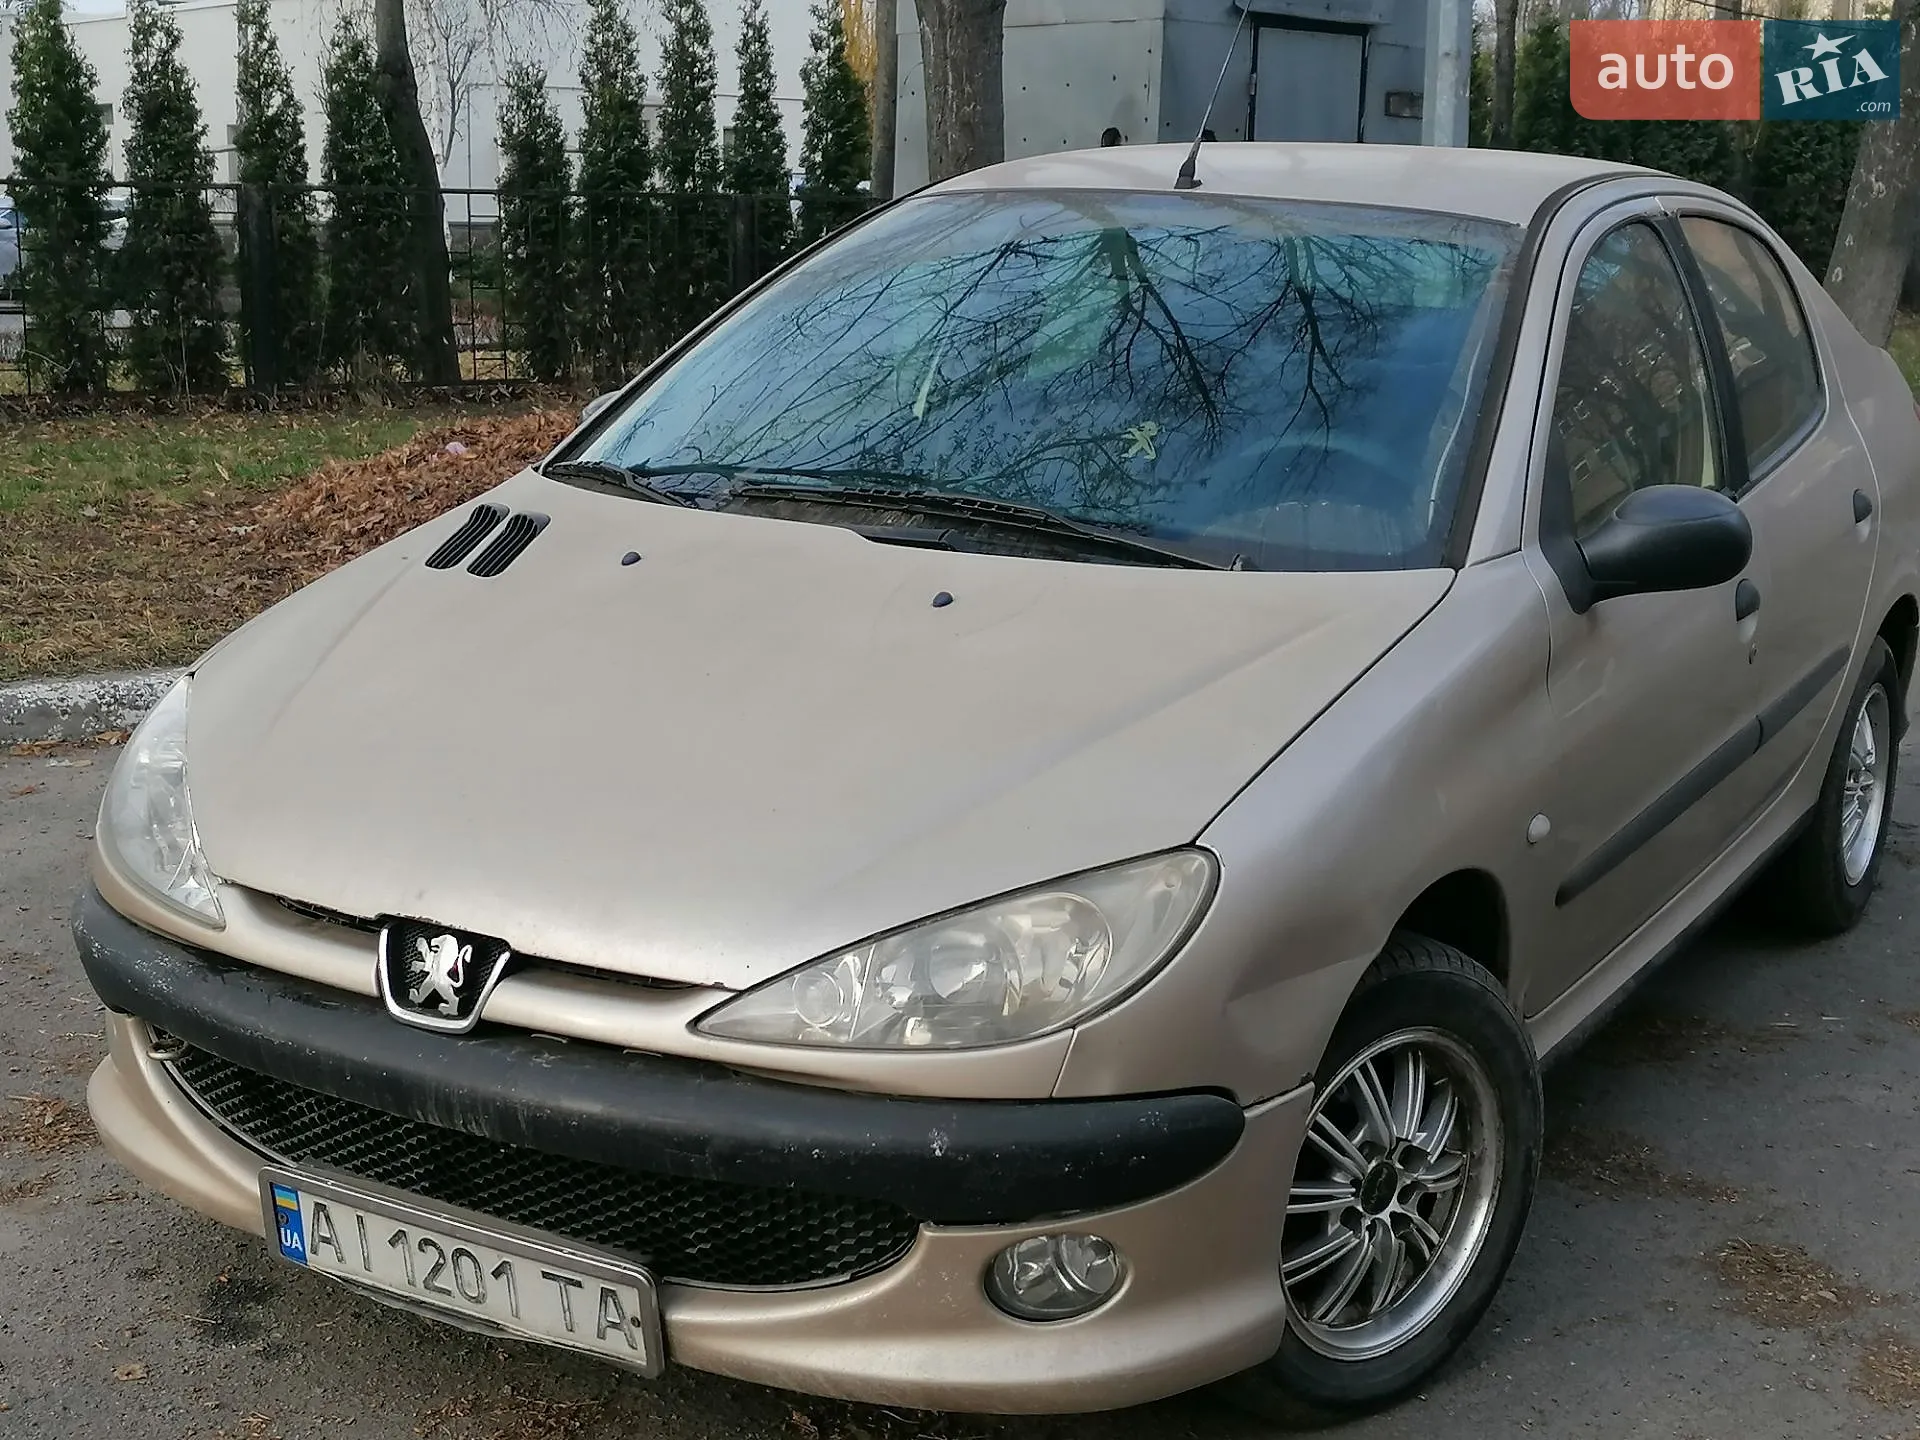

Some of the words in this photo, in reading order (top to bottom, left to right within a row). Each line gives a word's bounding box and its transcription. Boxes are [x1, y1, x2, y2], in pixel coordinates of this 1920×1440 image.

[280, 1227, 302, 1252] UA
[310, 1202, 372, 1272] AI
[388, 1229, 520, 1320] 1201
[541, 1270, 638, 1350] TA
